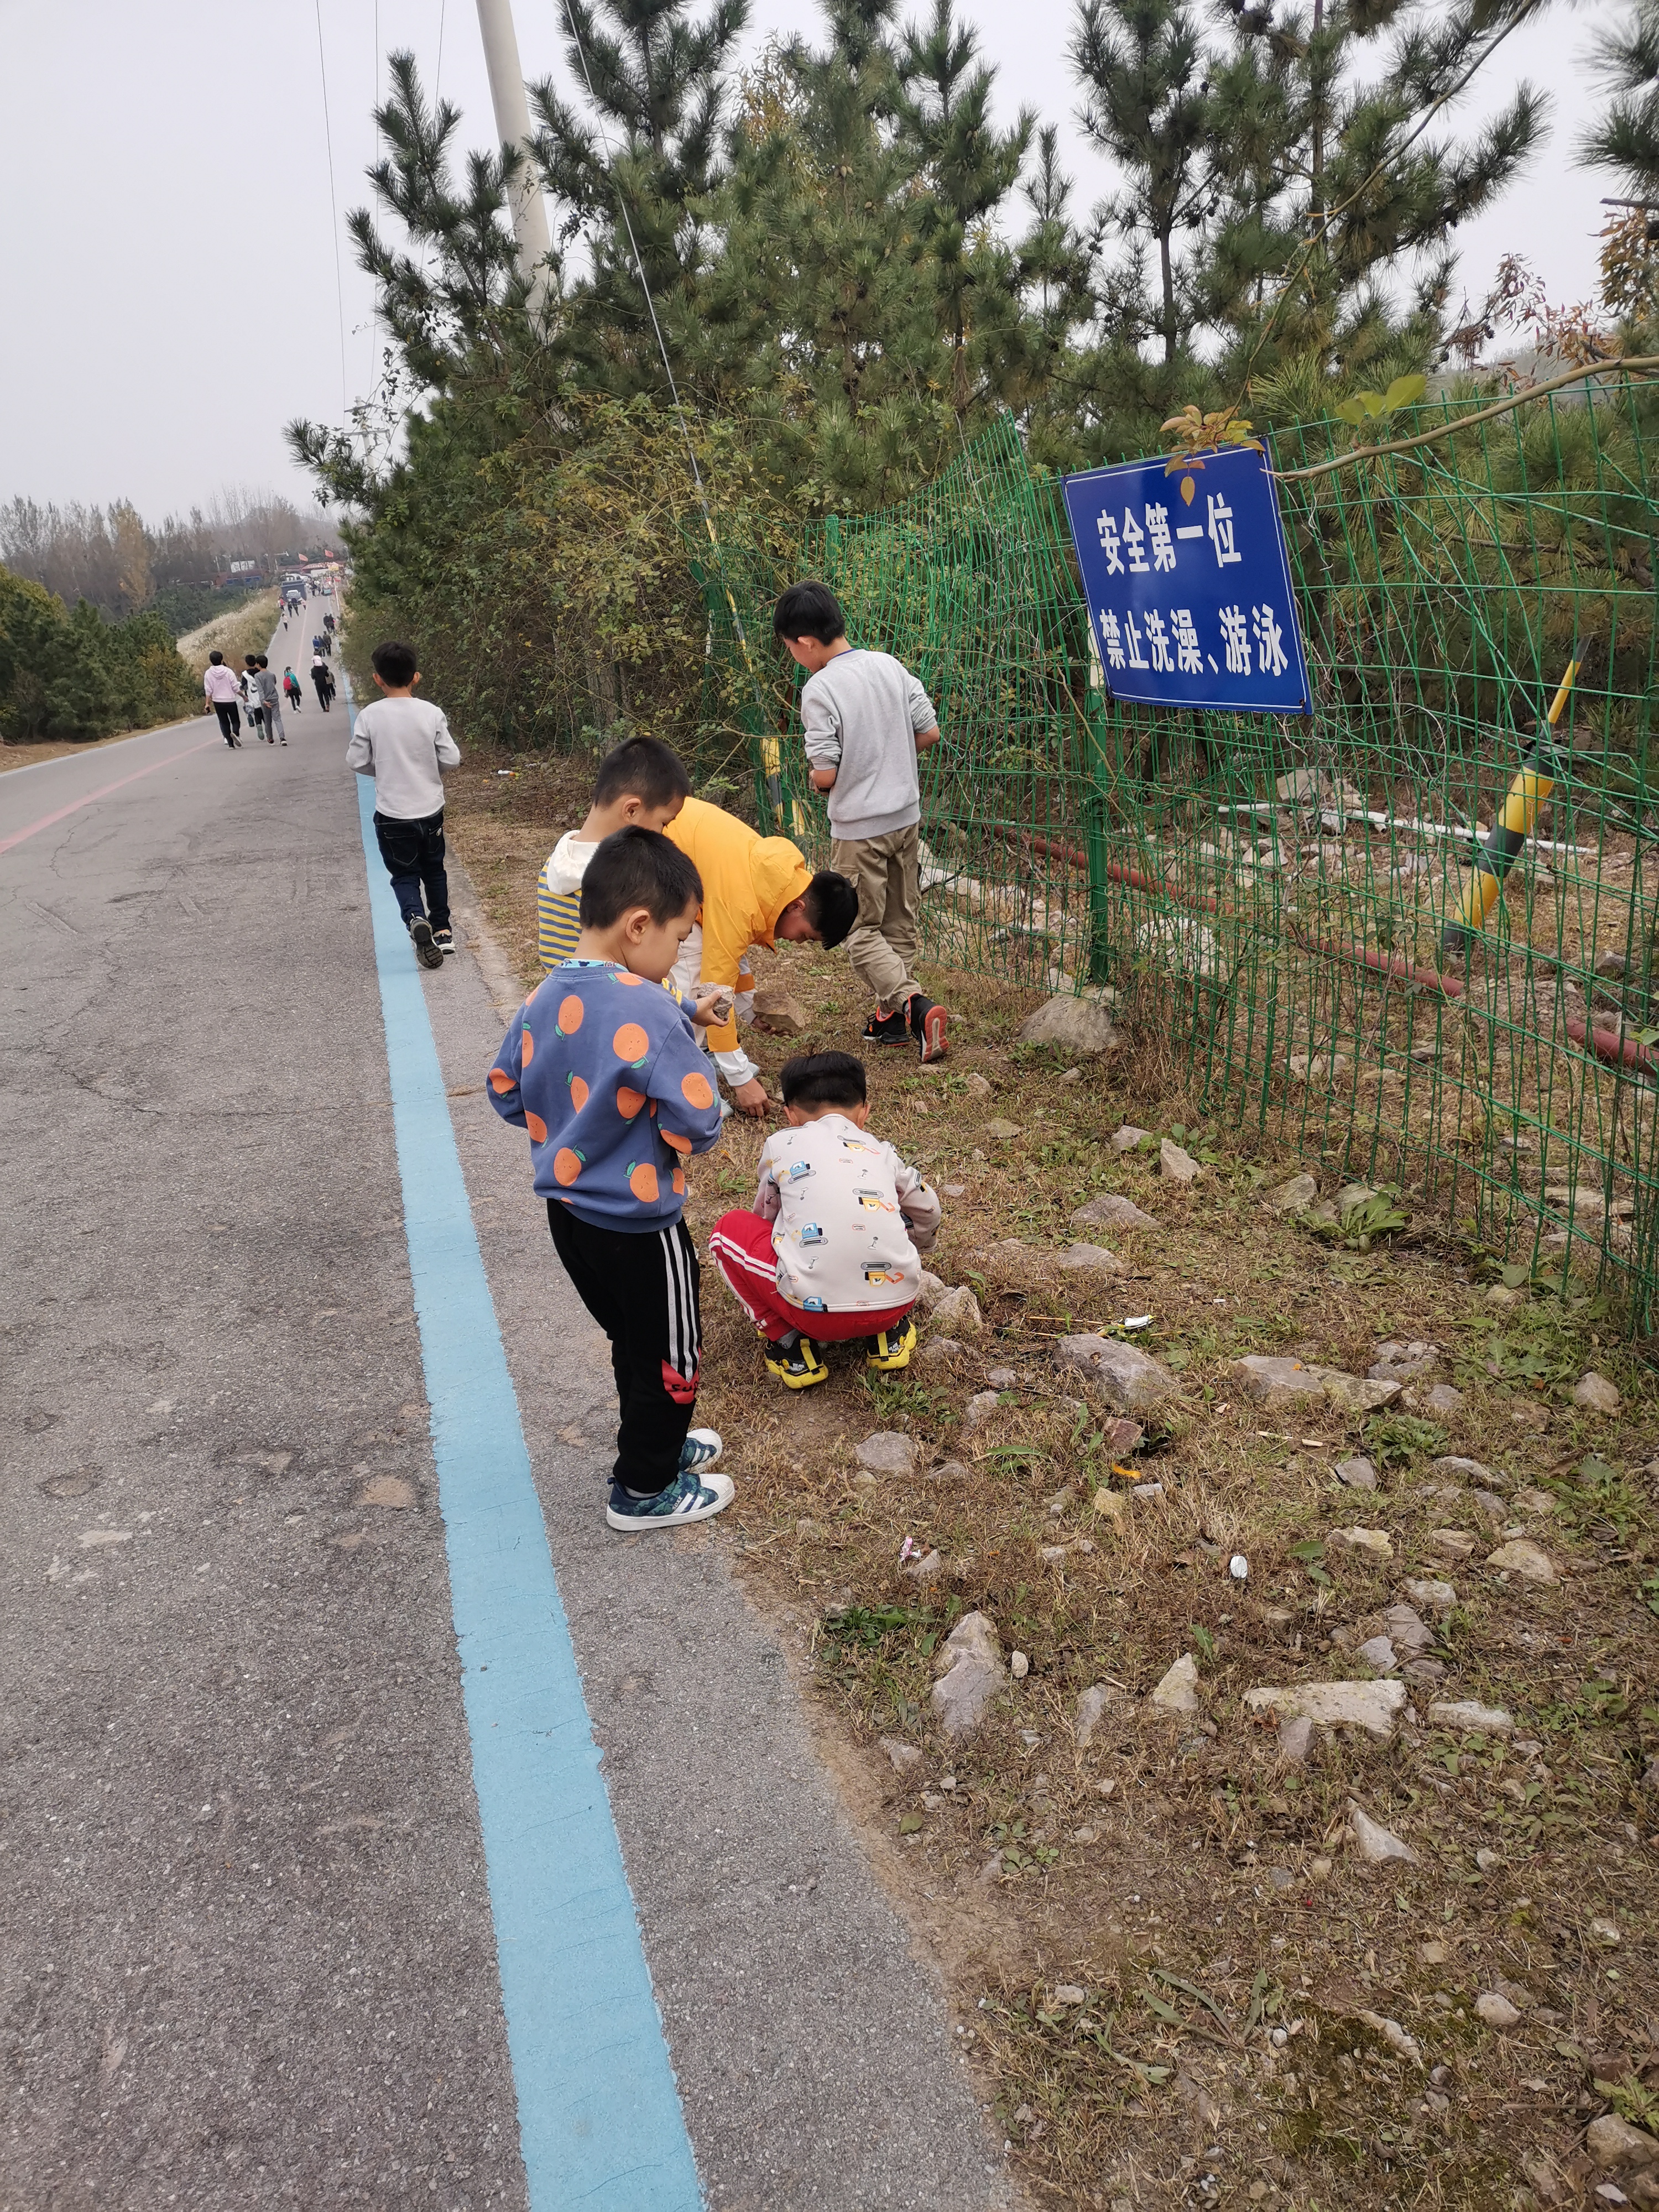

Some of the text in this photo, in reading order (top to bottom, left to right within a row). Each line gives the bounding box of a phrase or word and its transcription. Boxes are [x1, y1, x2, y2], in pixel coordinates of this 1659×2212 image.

[1097, 493, 1241, 575] 安全第一位
[1099, 603, 1288, 676] 禁止洗澡、游泳
